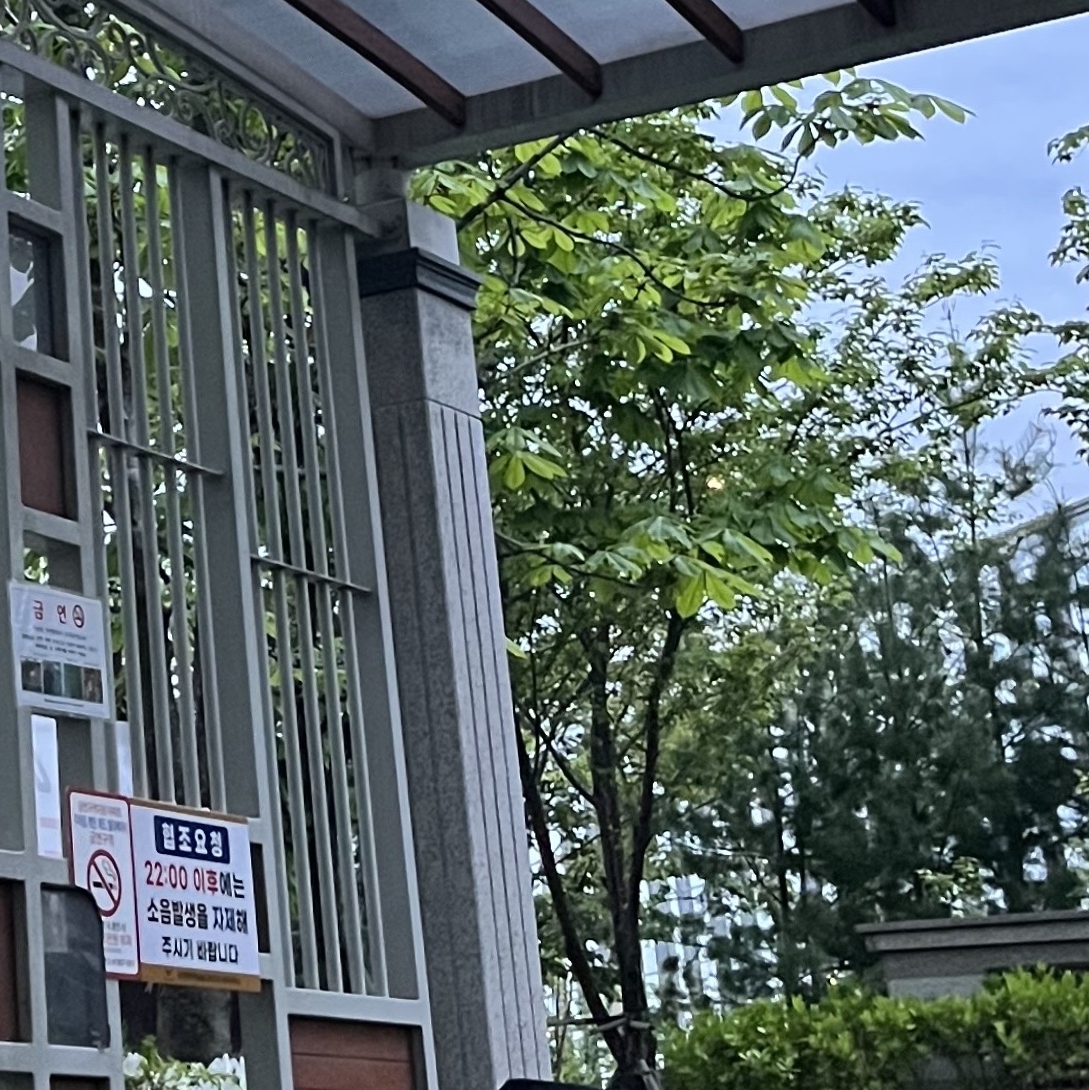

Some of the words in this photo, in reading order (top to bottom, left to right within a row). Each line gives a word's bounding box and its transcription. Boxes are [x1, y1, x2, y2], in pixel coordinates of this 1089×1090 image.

[162, 822, 223, 857] 협조요청
[145, 860, 187, 890] 22:00
[194, 868, 245, 898] 이후에는
[148, 897, 208, 930] 소음발생을
[212, 905, 248, 934] 자제해
[162, 936, 194, 960] 주시기
[196, 940, 238, 964] 바랍니다
